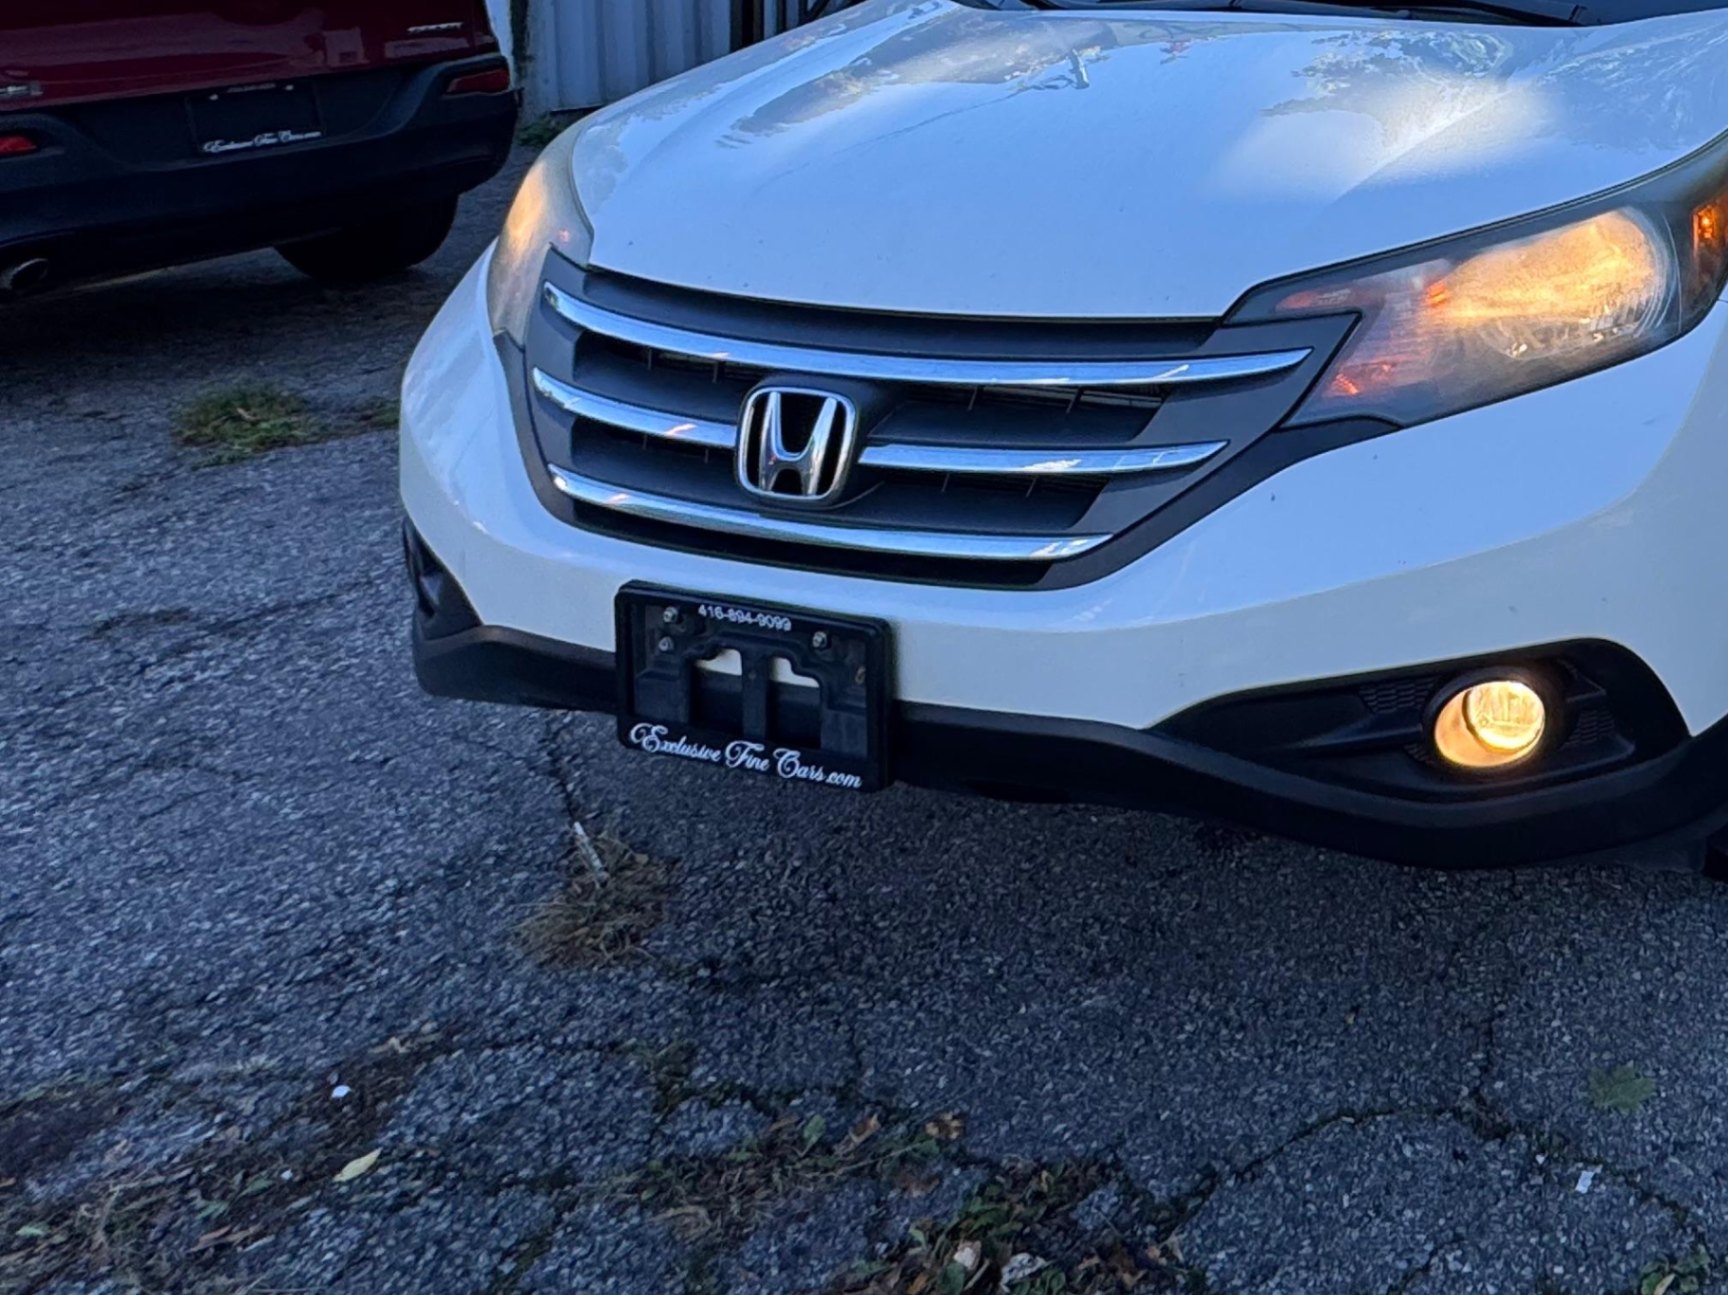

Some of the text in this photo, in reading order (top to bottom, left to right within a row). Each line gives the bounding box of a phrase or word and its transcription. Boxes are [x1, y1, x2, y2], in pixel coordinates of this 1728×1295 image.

[698, 604, 792, 631] 416-894-9099
[630, 722, 721, 762] Exclusive
[725, 740, 770, 771] Fine
